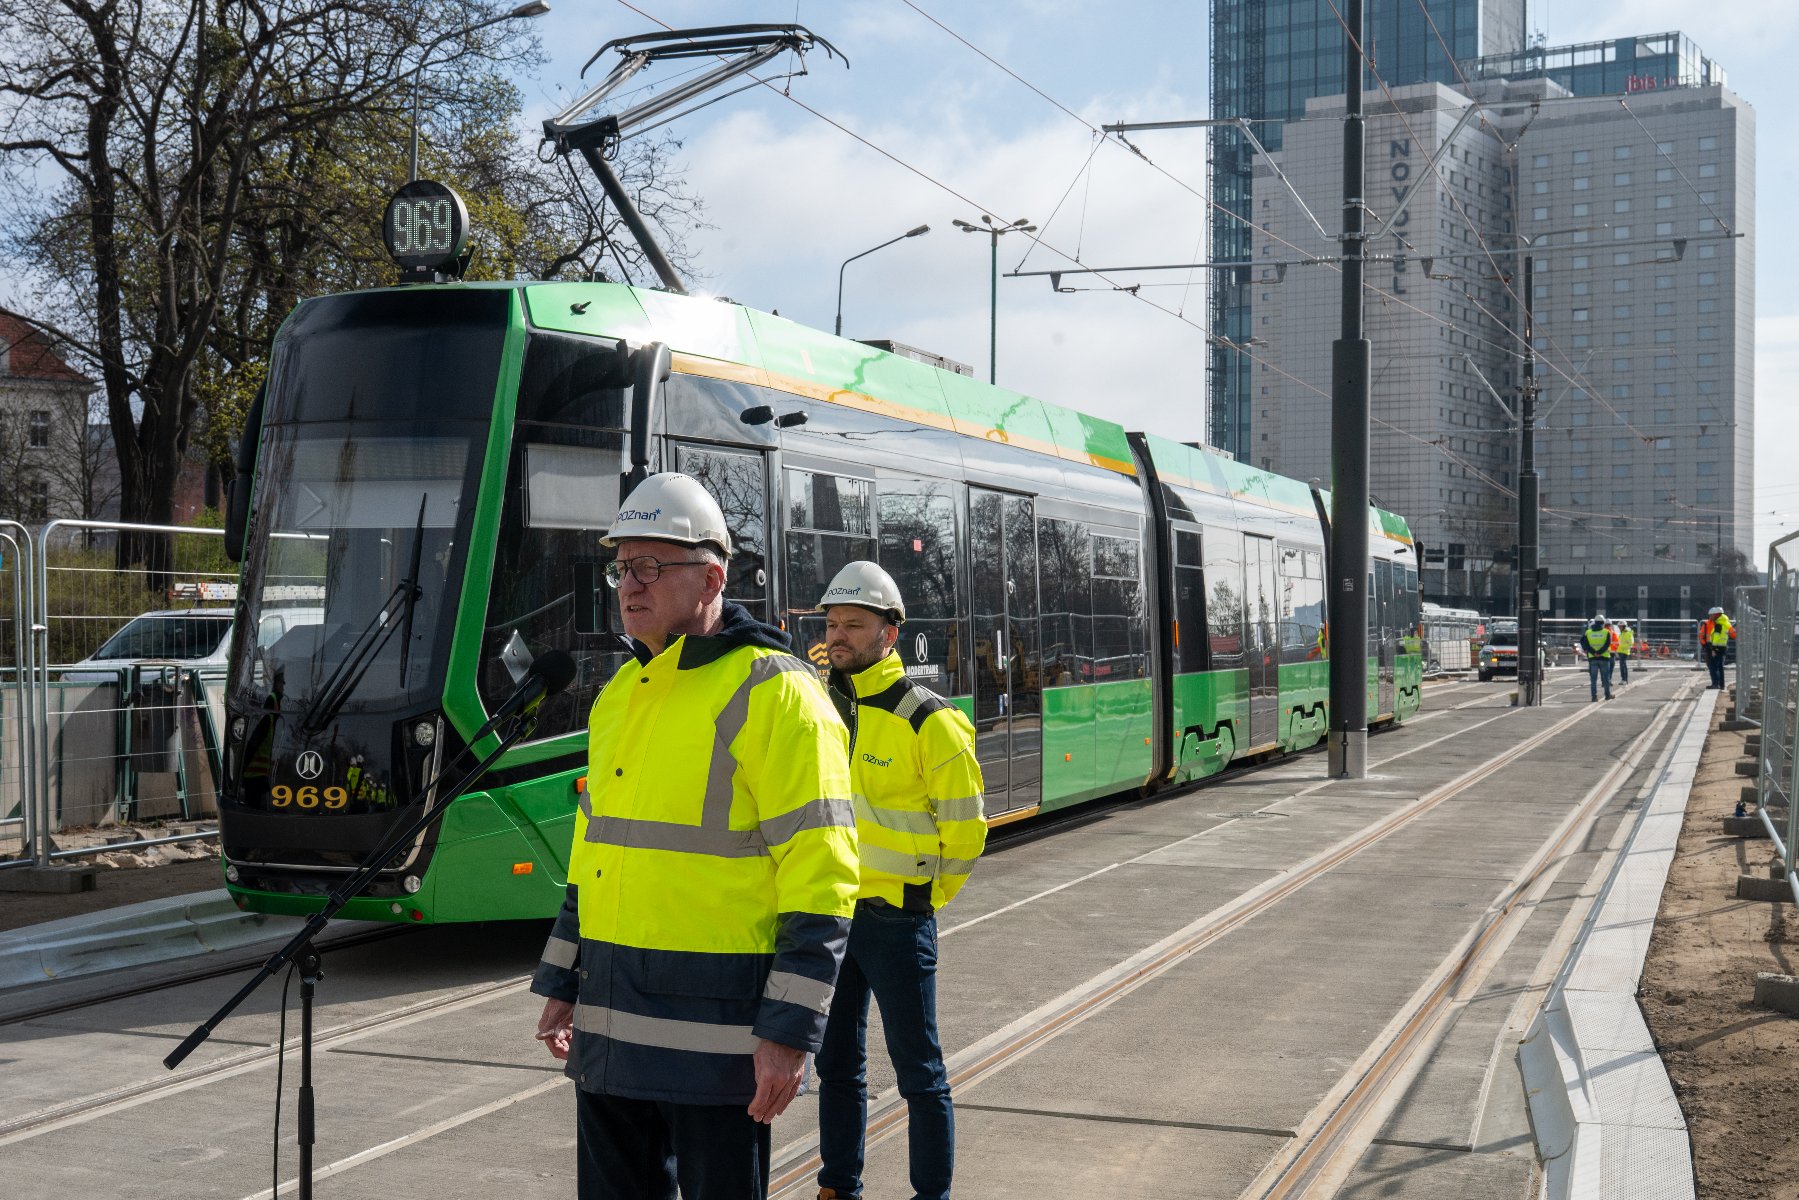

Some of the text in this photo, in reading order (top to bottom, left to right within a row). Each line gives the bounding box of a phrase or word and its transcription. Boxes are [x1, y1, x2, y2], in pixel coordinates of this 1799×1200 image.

[393, 199, 452, 252] 969
[1390, 138, 1410, 295] NOVOTEL
[271, 784, 348, 809] 969
